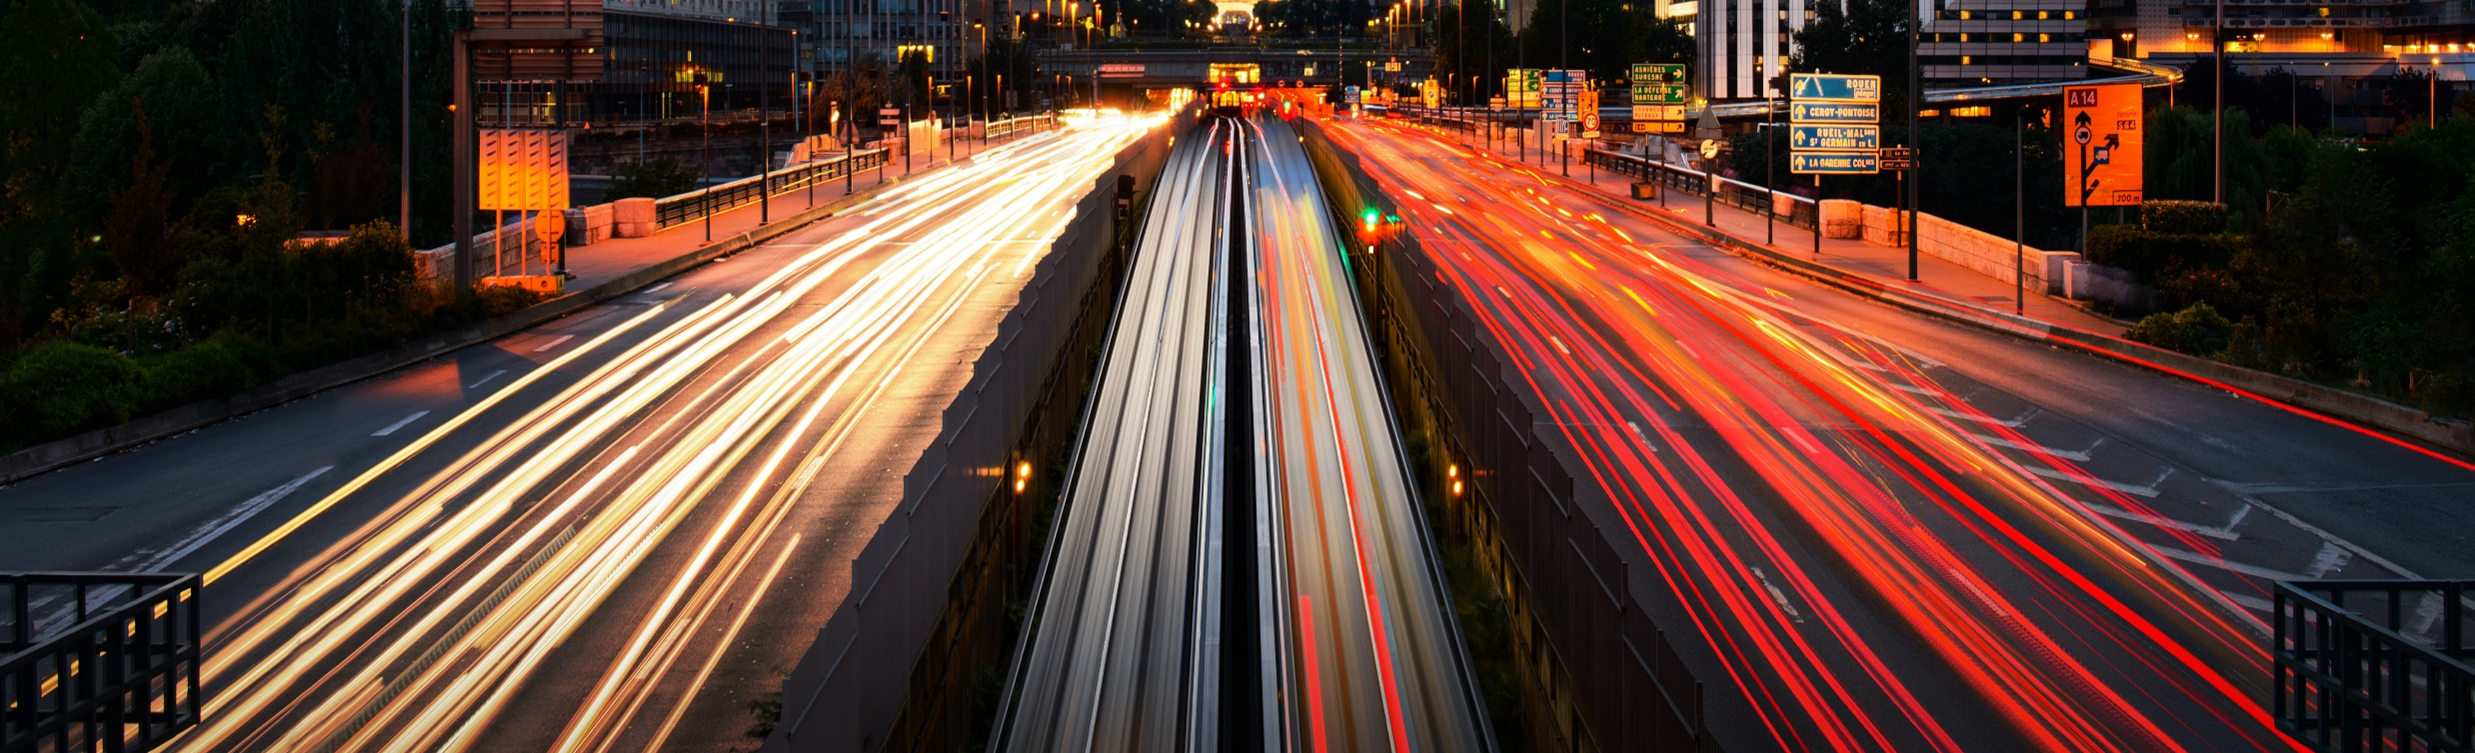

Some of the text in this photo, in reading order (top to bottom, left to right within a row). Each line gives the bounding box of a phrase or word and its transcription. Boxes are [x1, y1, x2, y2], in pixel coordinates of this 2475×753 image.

[1846, 79, 1876, 88] ROUEN
[2070, 91, 2095, 105] A 14
[1809, 107, 1875, 117] CERGY-PONTOISE
[1587, 118, 1596, 126] 70
[1821, 138, 1856, 147] GERMAIN
[1809, 158, 1818, 167] LA
[1820, 158, 1852, 168] GARENNE
[2116, 194, 2132, 203] 300
